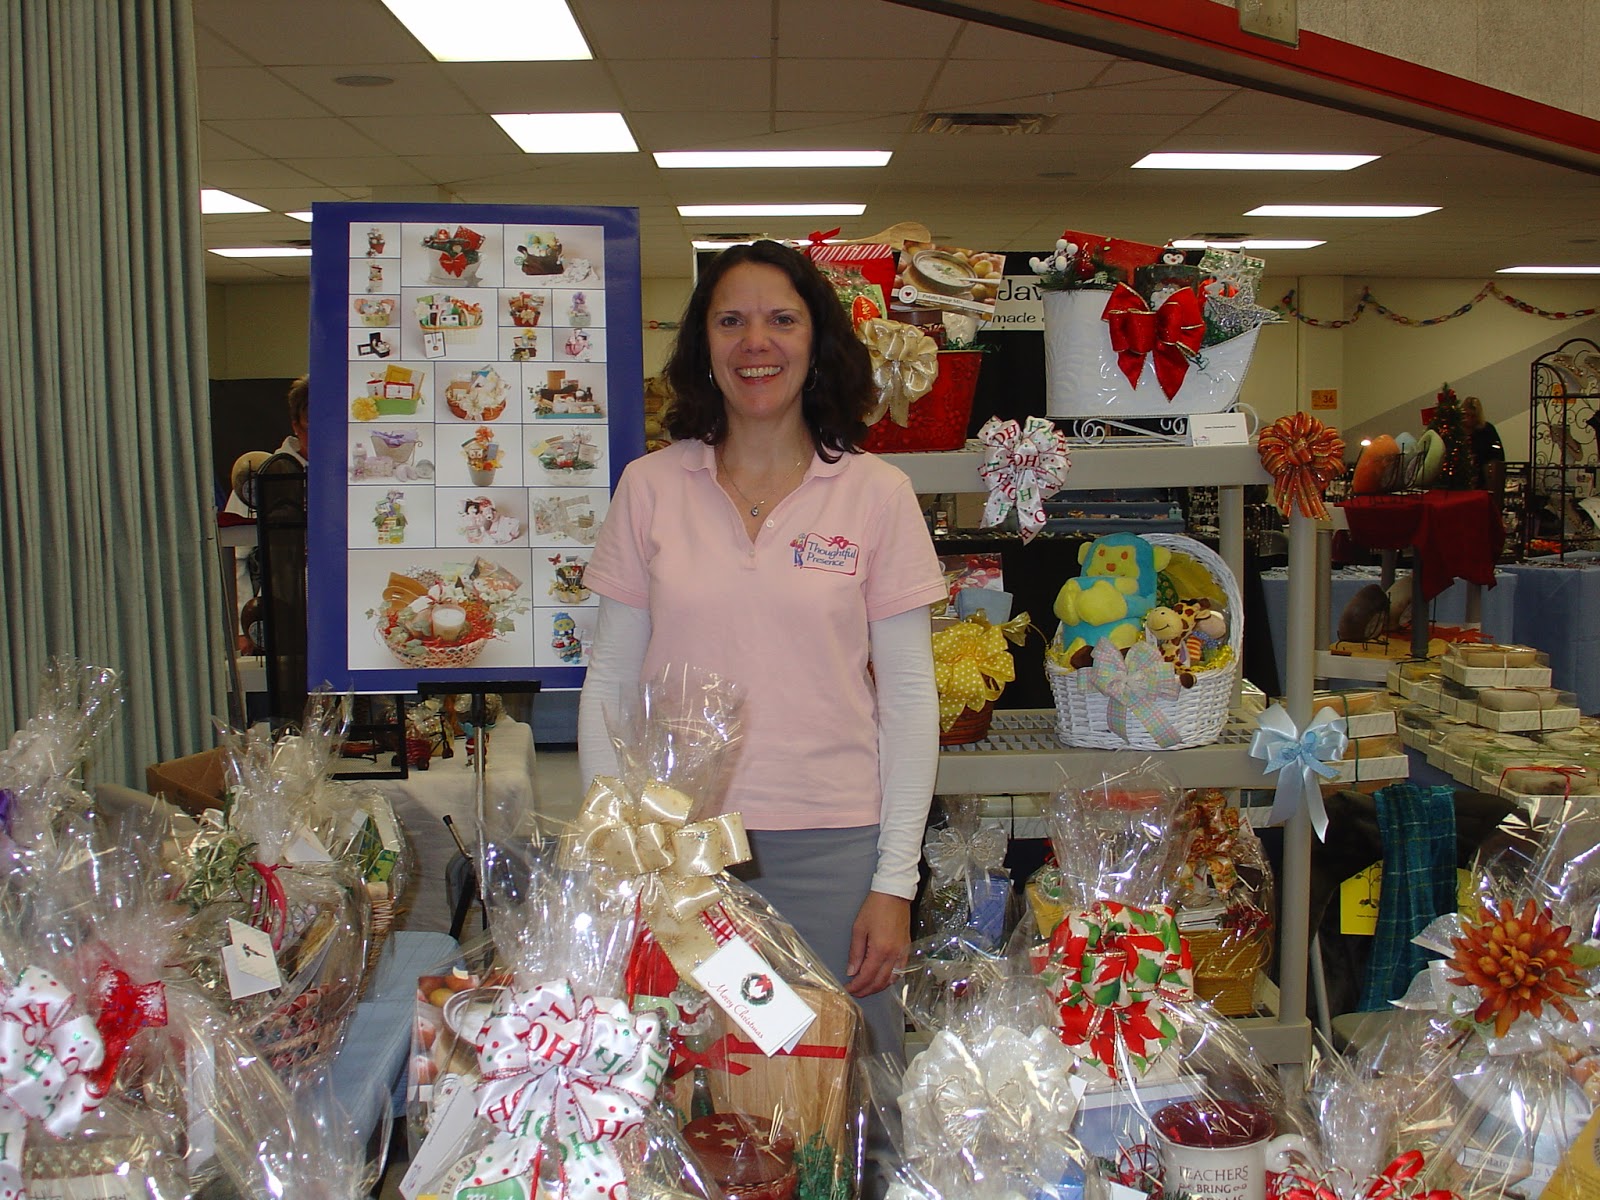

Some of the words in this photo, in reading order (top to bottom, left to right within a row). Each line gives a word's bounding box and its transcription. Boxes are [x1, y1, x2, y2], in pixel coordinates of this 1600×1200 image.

[922, 293, 938, 301] Potato
[992, 312, 1036, 323] made
[807, 540, 858, 560] Thoughtful
[806, 552, 845, 567] Presence
[707, 981, 734, 1009] Merry
[733, 1004, 765, 1040] Christmas
[1178, 1165, 1249, 1182] TEACHERS
[441, 1175, 456, 1196] THE
[1196, 1183, 1232, 1194] BRING
